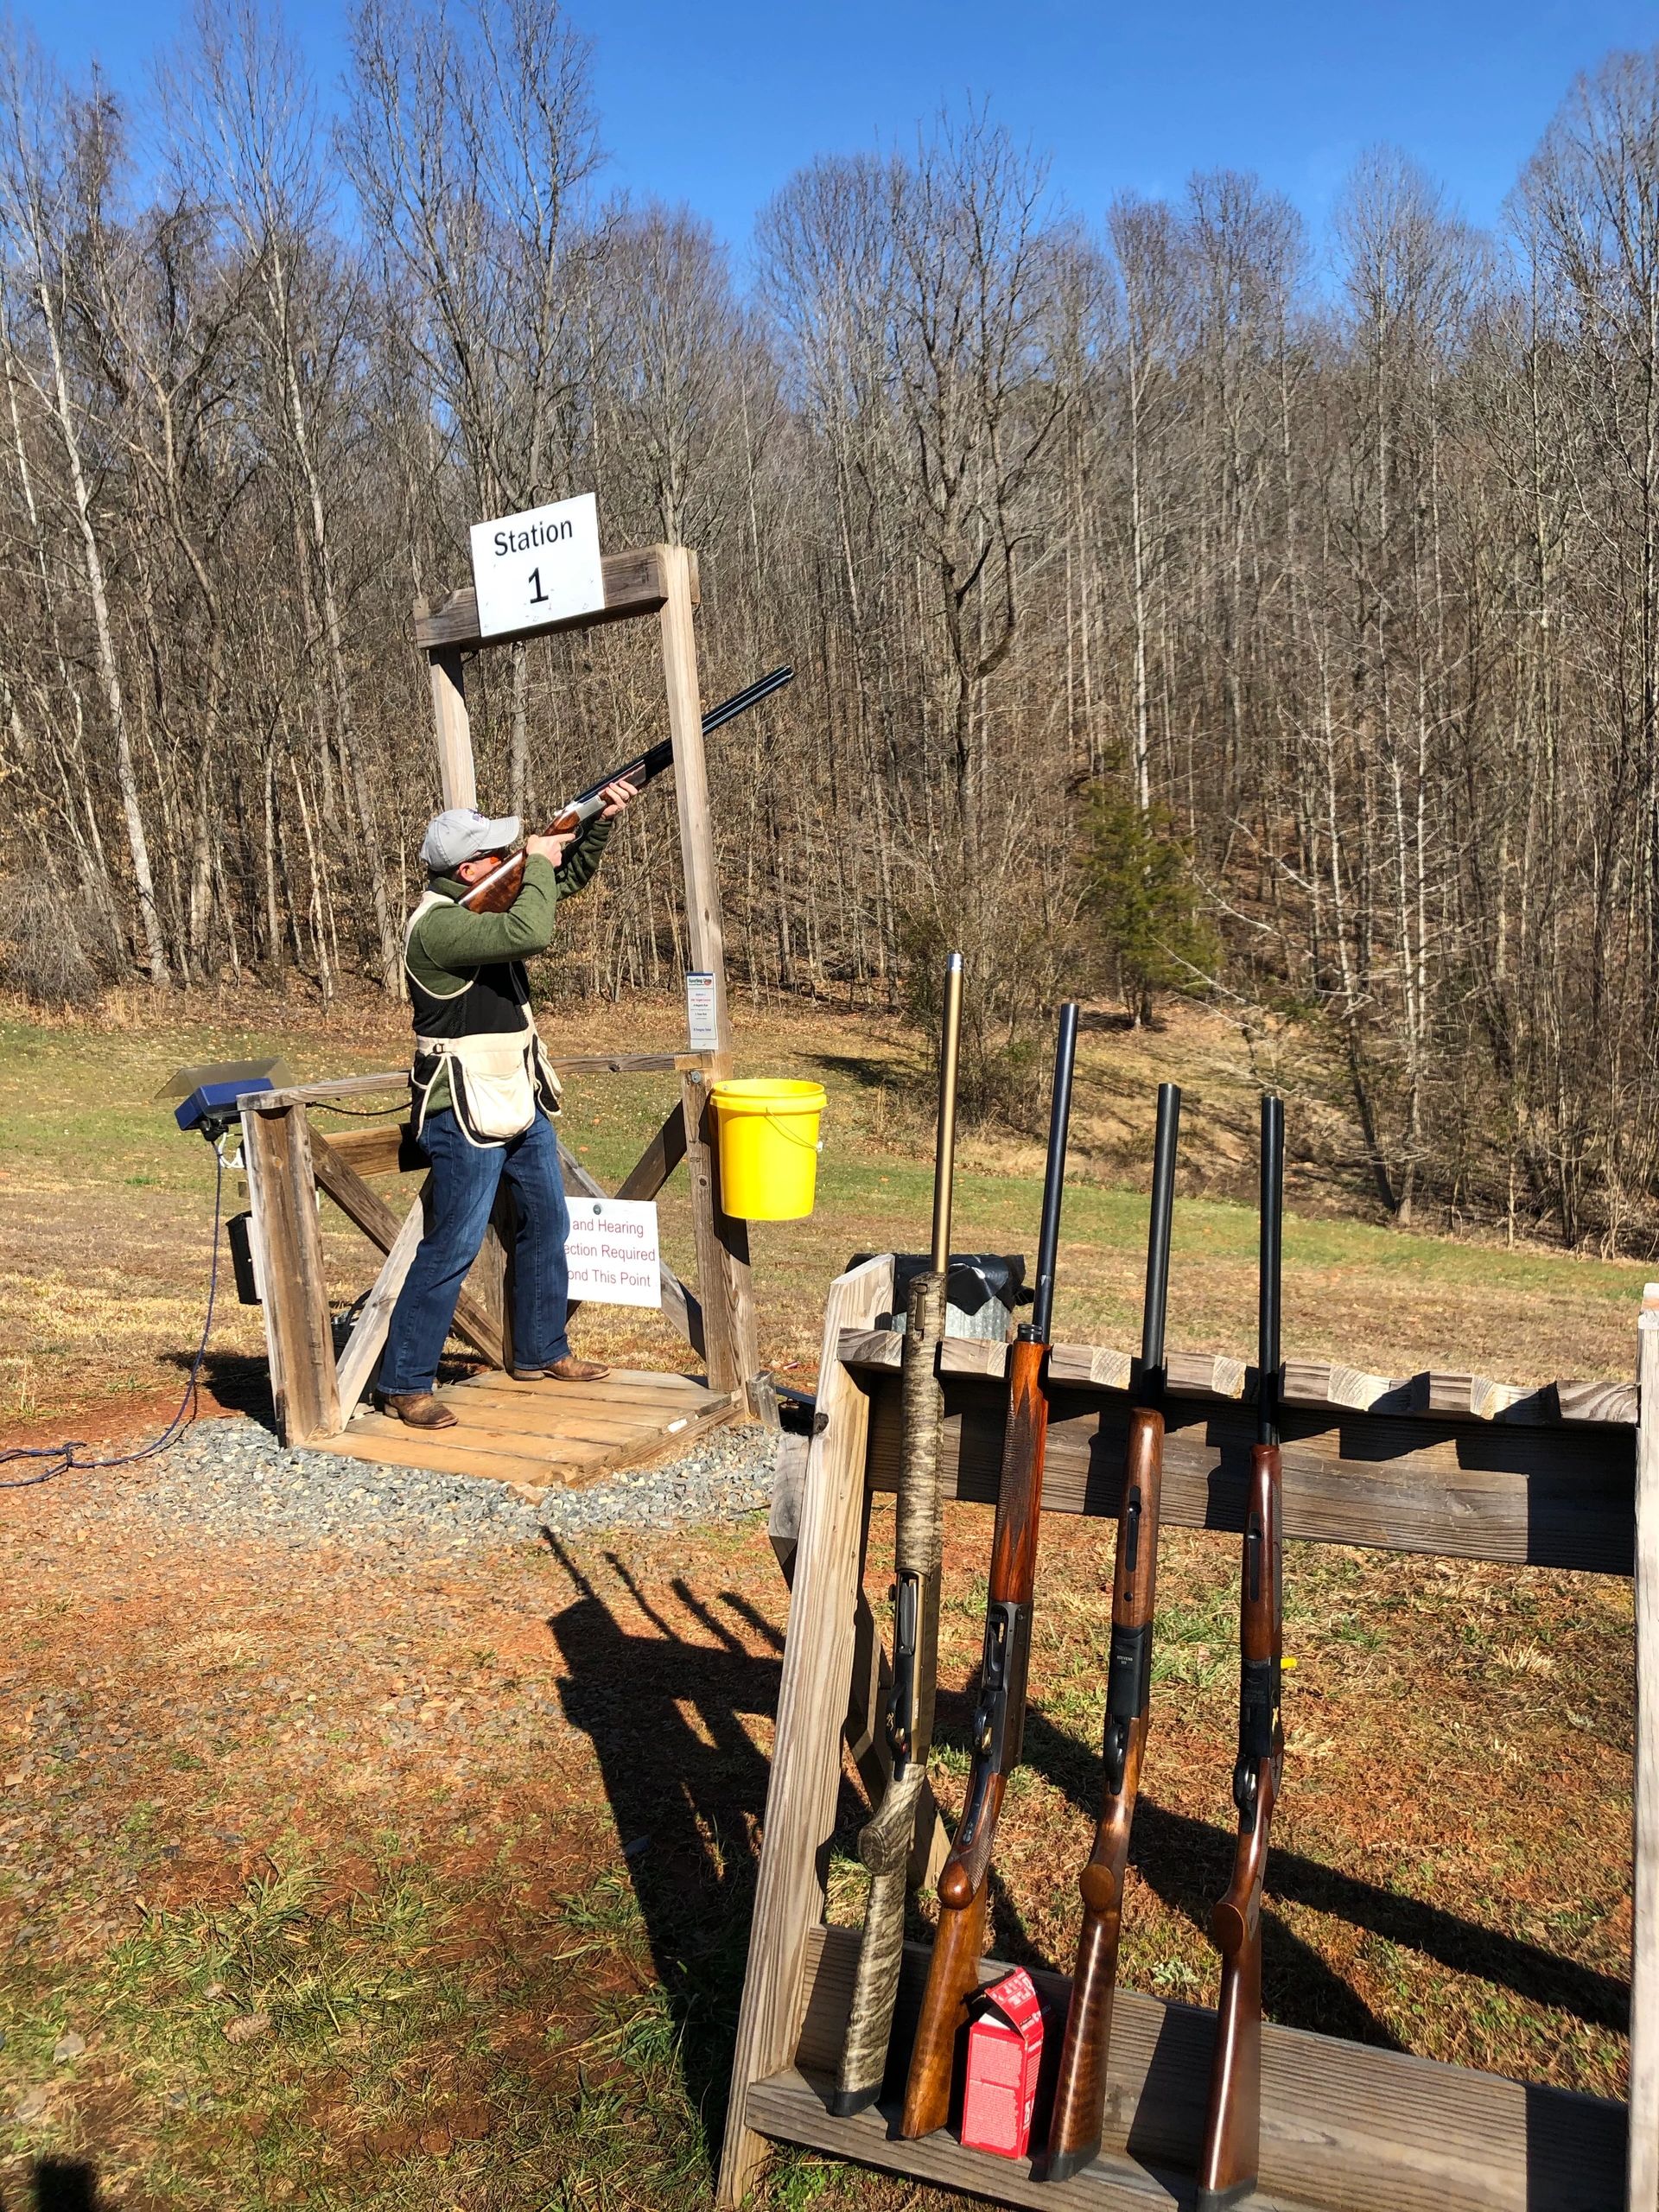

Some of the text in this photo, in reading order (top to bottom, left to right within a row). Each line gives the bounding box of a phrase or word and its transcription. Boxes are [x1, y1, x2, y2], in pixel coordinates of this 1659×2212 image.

[494, 520, 573, 556] Station
[528, 567, 549, 604] 1
[572, 1218, 644, 1238] and Hearing
[564, 1243, 656, 1262] ection Required
[567, 1268, 652, 1287] ond This Point
